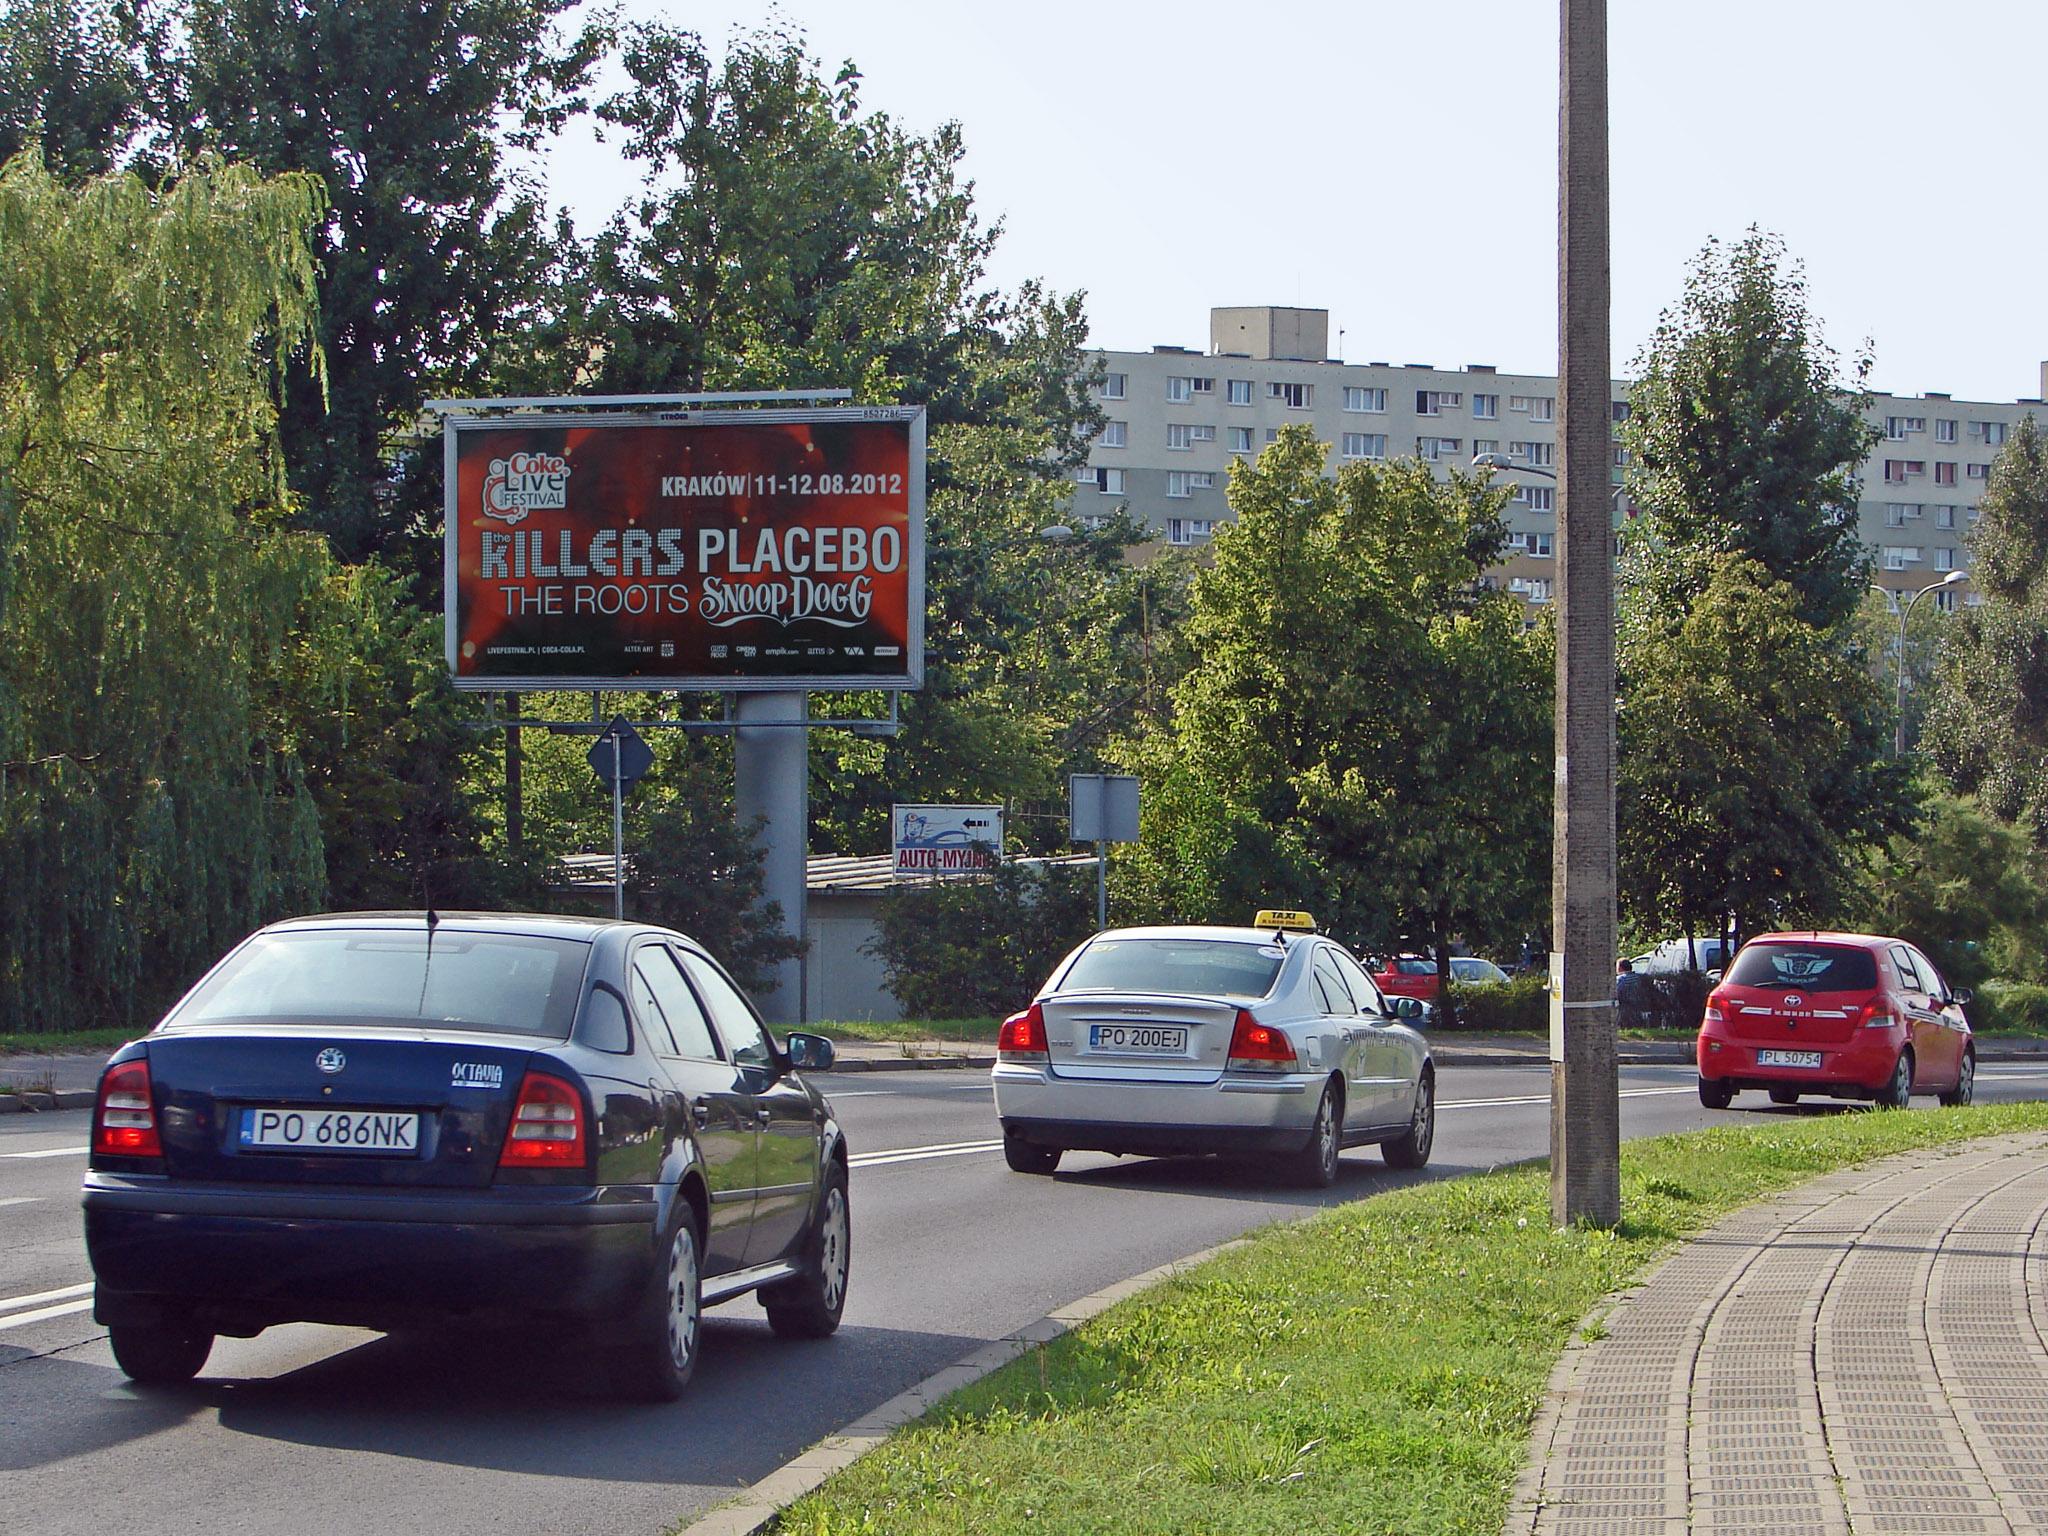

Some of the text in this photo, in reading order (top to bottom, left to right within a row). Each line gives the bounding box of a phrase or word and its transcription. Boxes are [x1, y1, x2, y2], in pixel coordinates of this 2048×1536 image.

[511, 454, 563, 474] Coke
[504, 464, 564, 492] Live
[661, 471, 902, 497] KRAKÓW 11-12.08.2012
[504, 492, 564, 506] FESTIVAL
[493, 532, 511, 543] the
[481, 528, 685, 579] KILLERS
[698, 526, 901, 574] PLACEBO
[499, 583, 690, 615] THE ROOTS
[1100, 1028, 1181, 1048] PO 200EJ
[1764, 1051, 1820, 1065] PL 50754
[452, 1062, 503, 1082] OCTAVIA
[259, 1112, 413, 1147] PO 686NK
